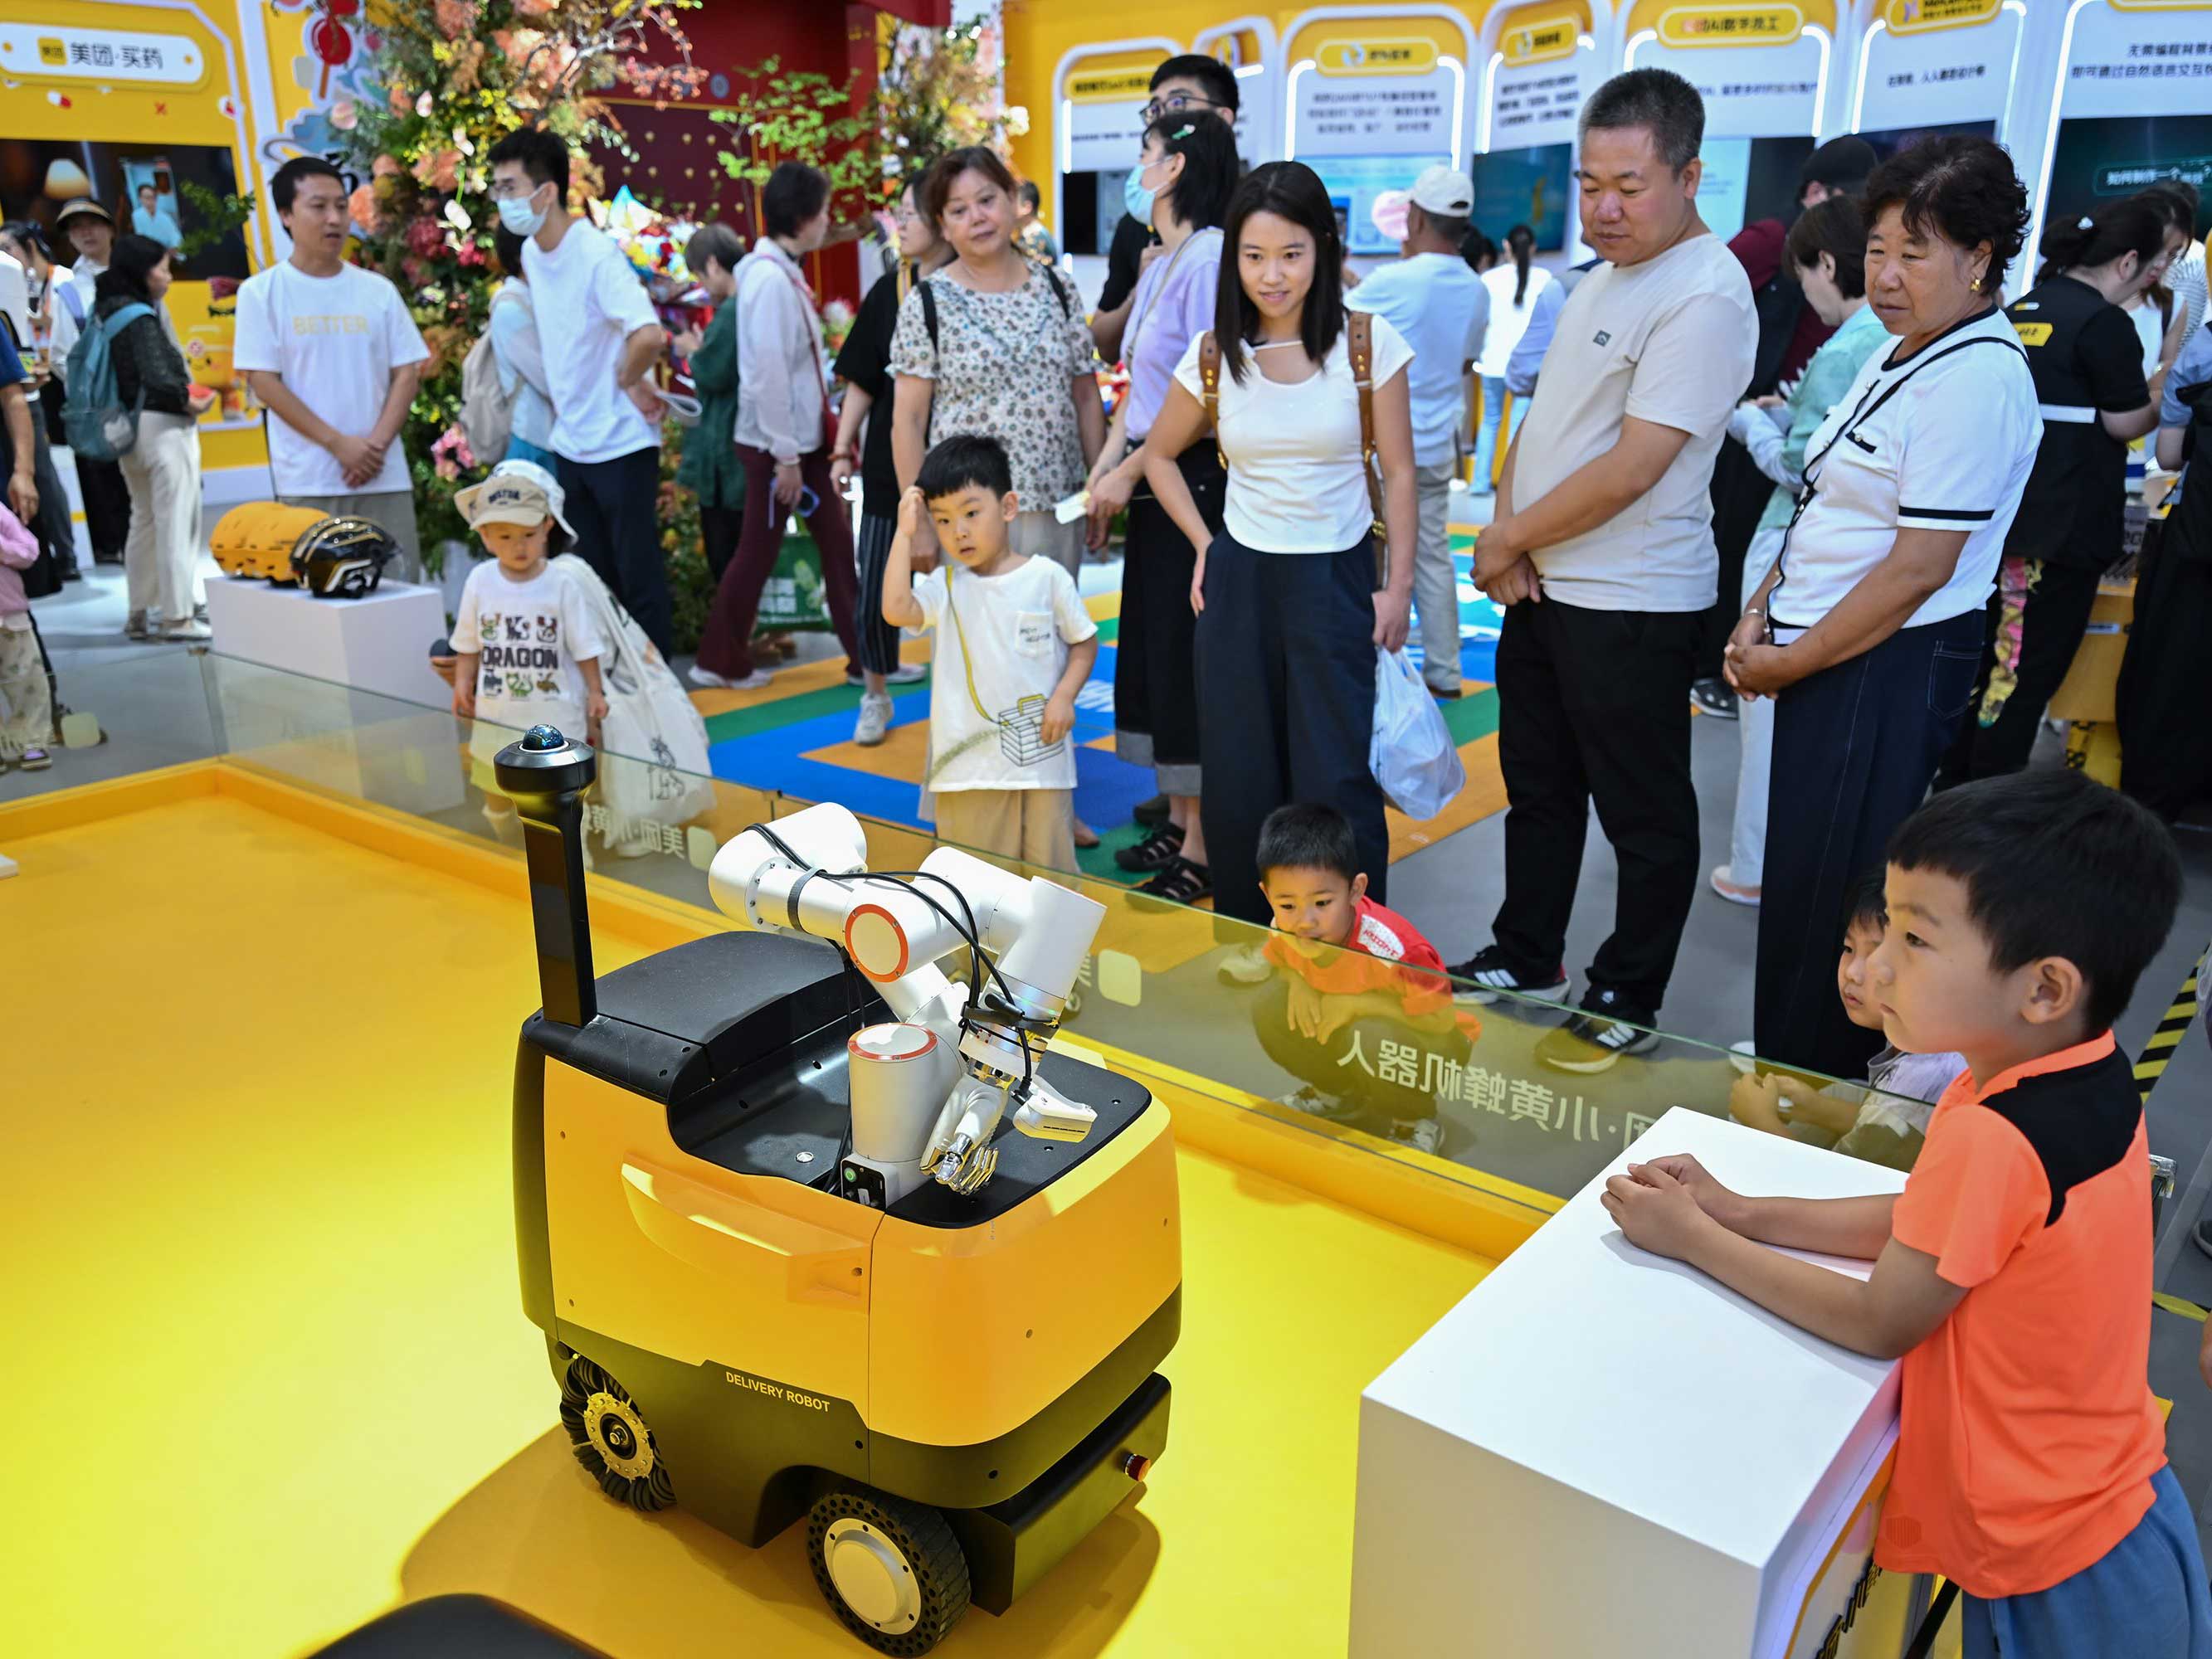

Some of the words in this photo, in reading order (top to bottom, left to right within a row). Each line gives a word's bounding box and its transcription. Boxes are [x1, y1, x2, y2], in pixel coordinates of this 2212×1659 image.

[71, 41, 163, 70] 美团·买药
[292, 315, 370, 335] BETTER
[483, 646, 558, 669] DRAGON
[725, 1371, 783, 1399] DELIVERY
[786, 1390, 830, 1412] ROBOT
